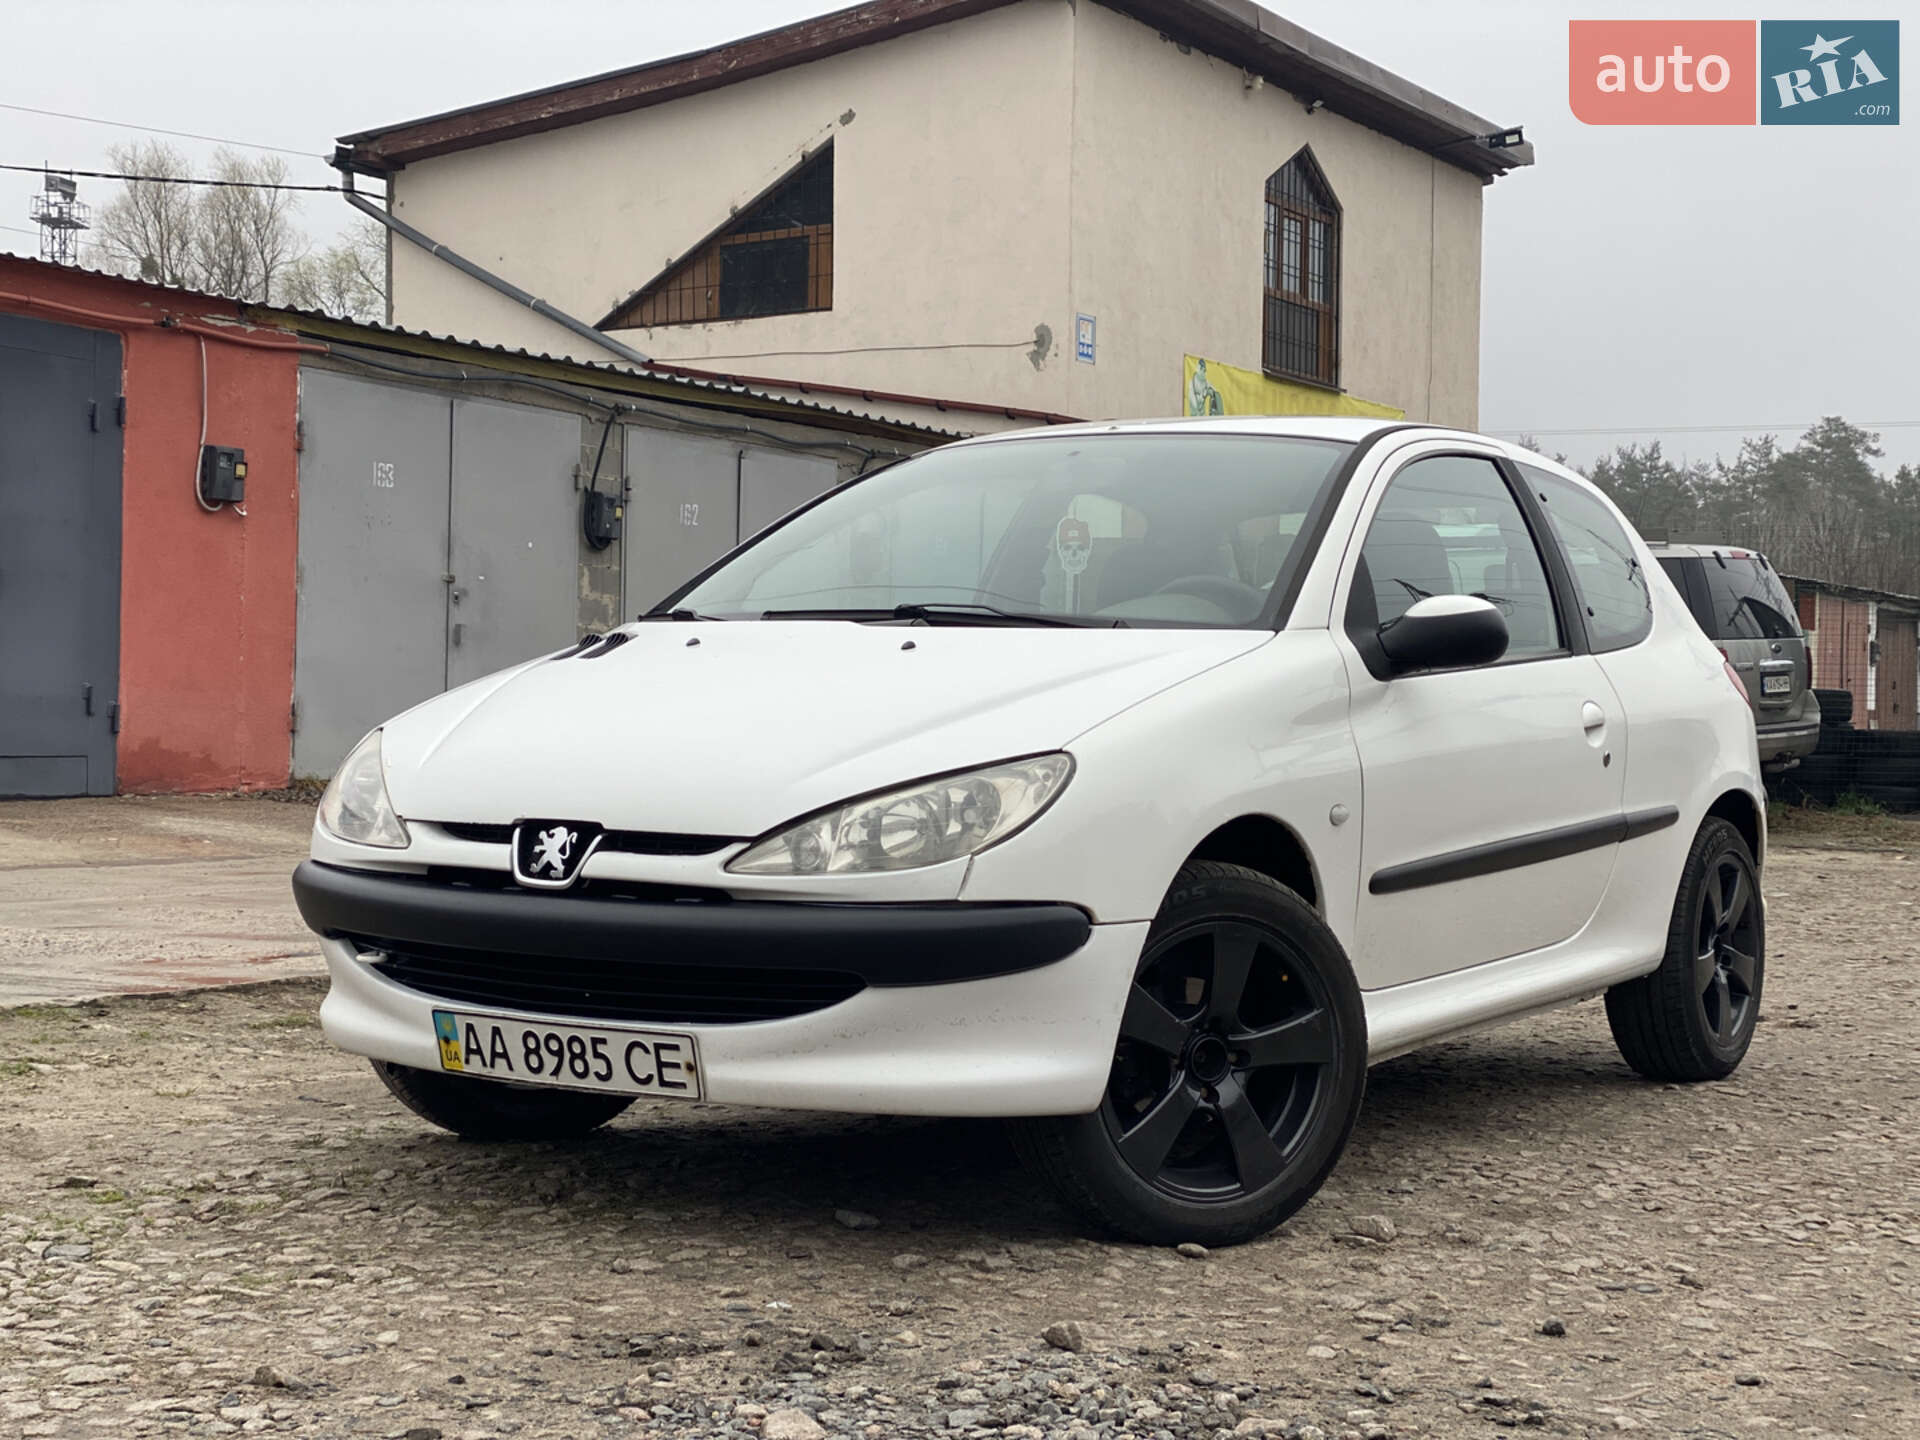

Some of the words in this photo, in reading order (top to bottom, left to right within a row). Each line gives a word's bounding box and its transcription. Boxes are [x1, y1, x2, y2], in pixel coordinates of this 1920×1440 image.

[445, 1049, 461, 1063] UA
[464, 1022, 514, 1072] AA
[522, 1030, 613, 1082] 8985
[624, 1040, 688, 1089] CE
